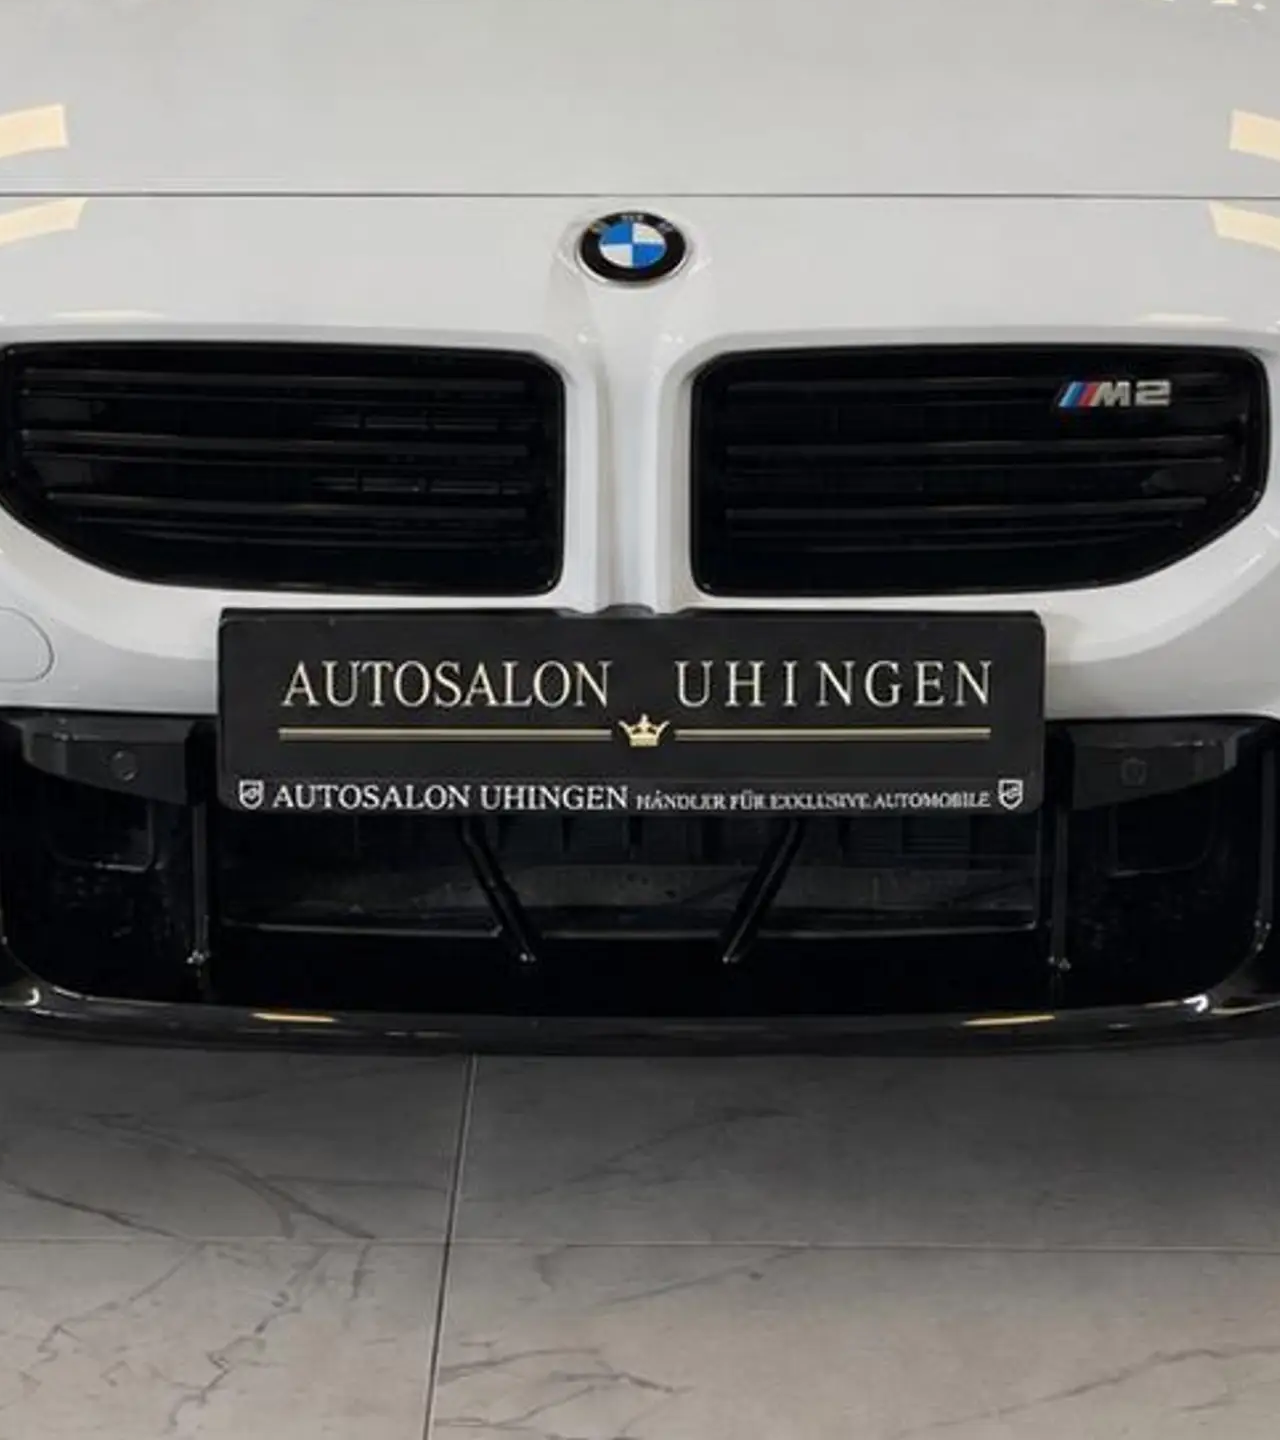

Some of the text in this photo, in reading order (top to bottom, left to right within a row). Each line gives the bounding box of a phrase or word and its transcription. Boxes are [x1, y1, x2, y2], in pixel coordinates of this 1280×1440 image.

[1090, 380, 1171, 407] M2
[281, 659, 992, 707] AUTOSALON UHINGEN
[273, 784, 471, 810] AUTOSALON
[480, 784, 628, 810] UHINGEN
[730, 789, 763, 810] FÜR
[873, 791, 991, 809] AUTOMOBILE
